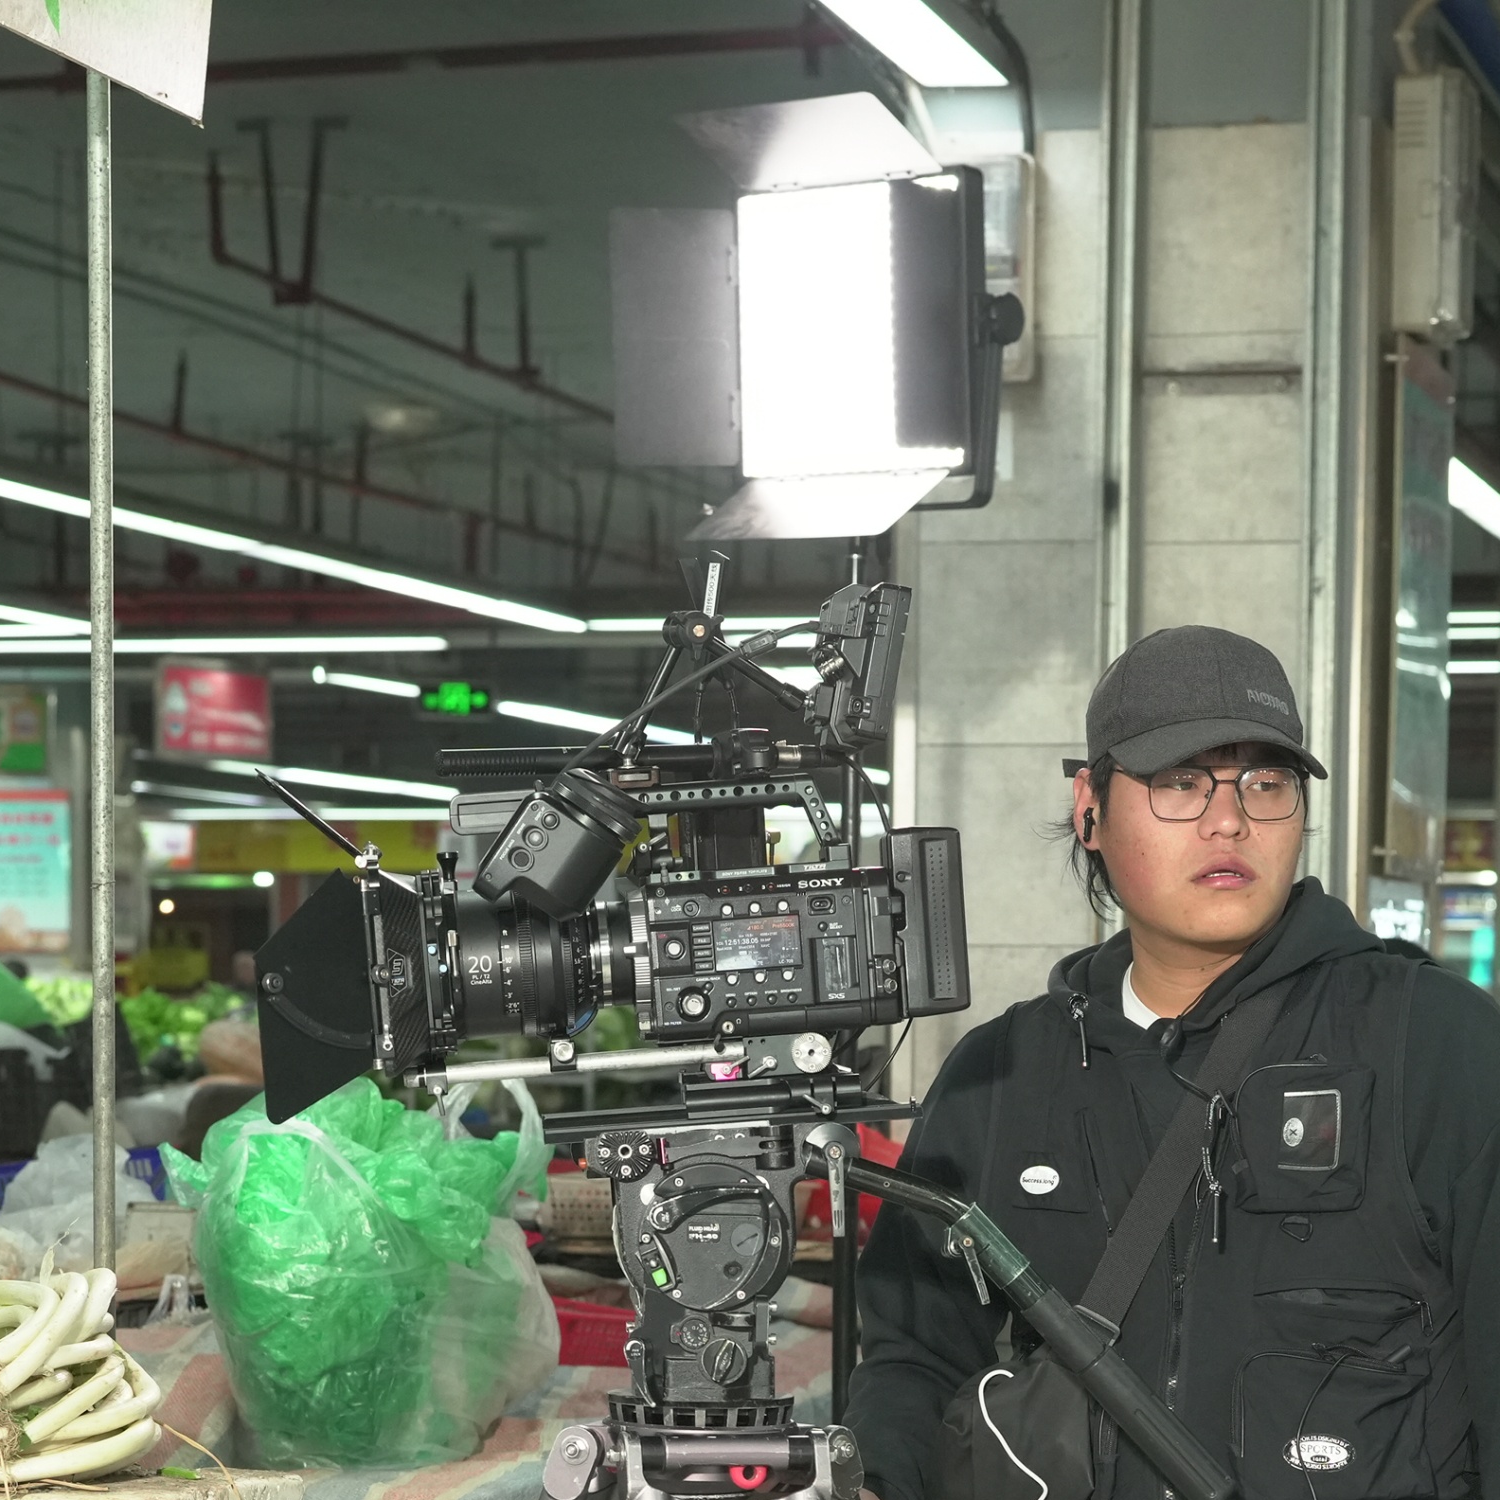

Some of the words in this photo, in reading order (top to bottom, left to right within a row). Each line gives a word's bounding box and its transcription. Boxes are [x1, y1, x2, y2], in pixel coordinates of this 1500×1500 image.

[798, 877, 844, 889] SONY
[468, 955, 492, 974] 20
[1301, 1444, 1341, 1456] SPORTS
